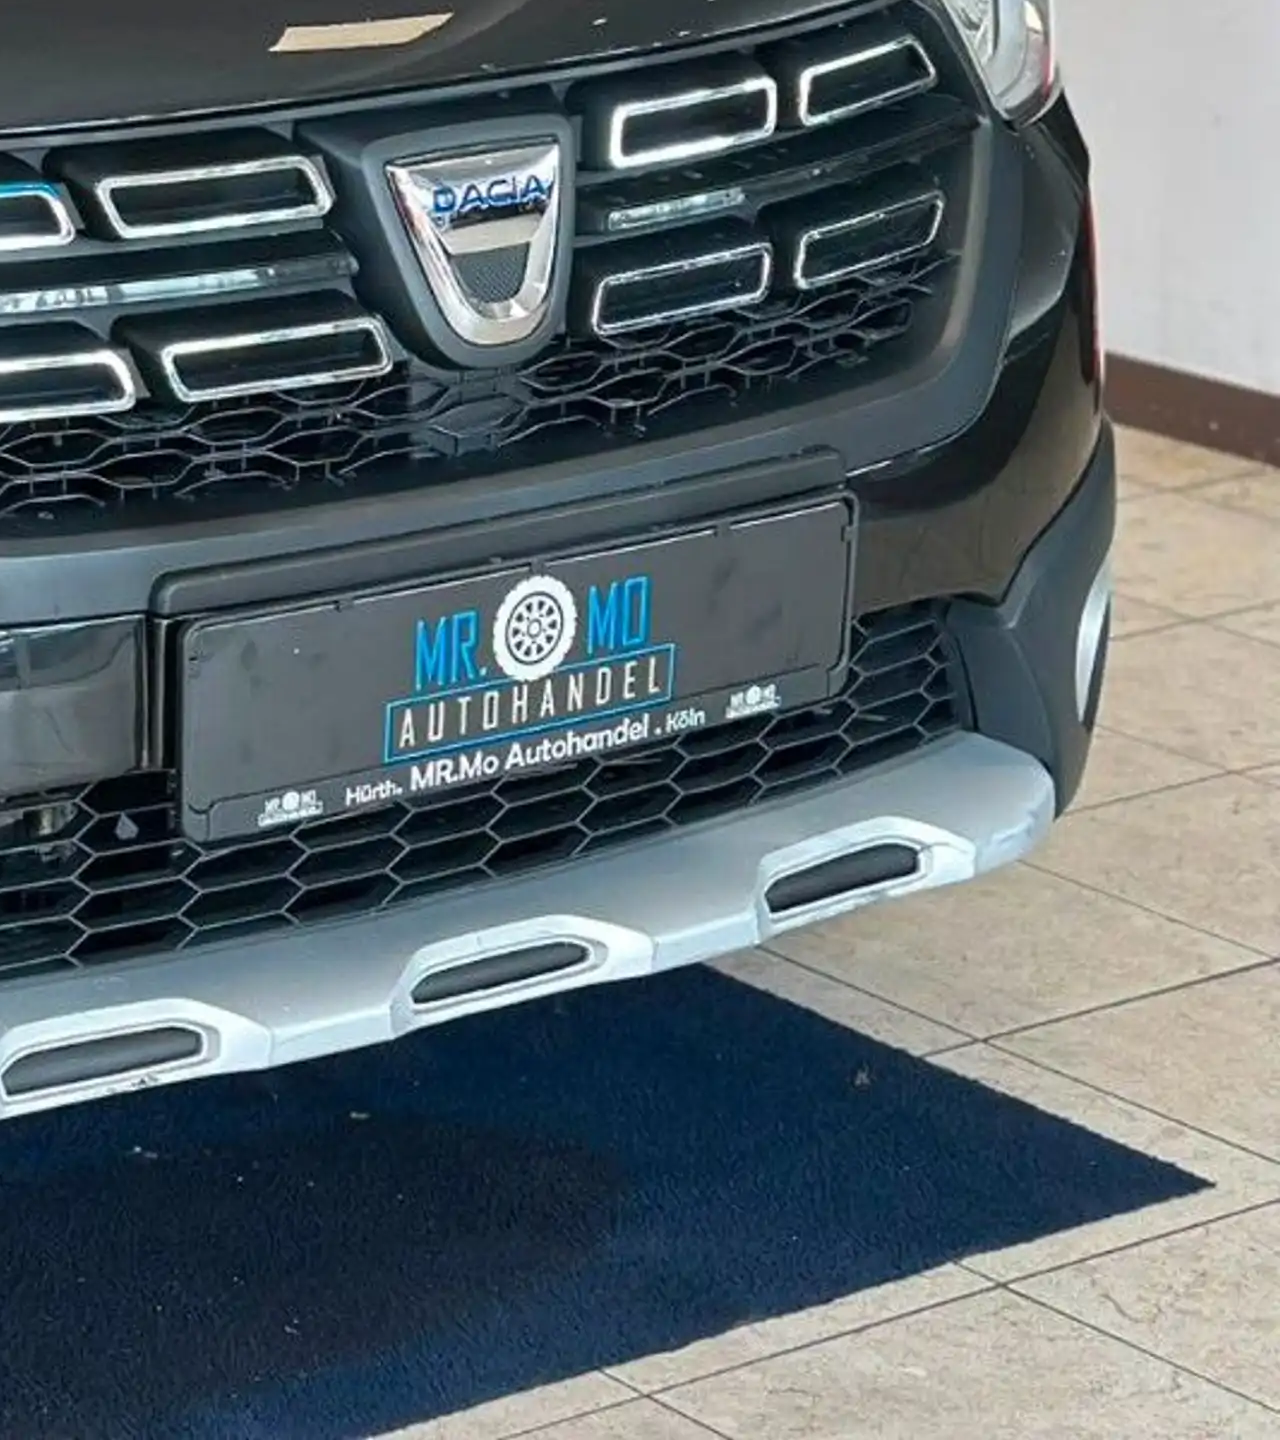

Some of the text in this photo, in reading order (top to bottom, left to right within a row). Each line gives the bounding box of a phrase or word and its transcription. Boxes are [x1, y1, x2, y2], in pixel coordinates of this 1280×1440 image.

[432, 173, 546, 213] DACIA
[415, 575, 652, 691] MR. MO
[398, 656, 661, 749] AUTOHANDEL
[410, 750, 499, 792] MR.Mo
[504, 713, 651, 770] Autohandel
[666, 706, 706, 733] Köln
